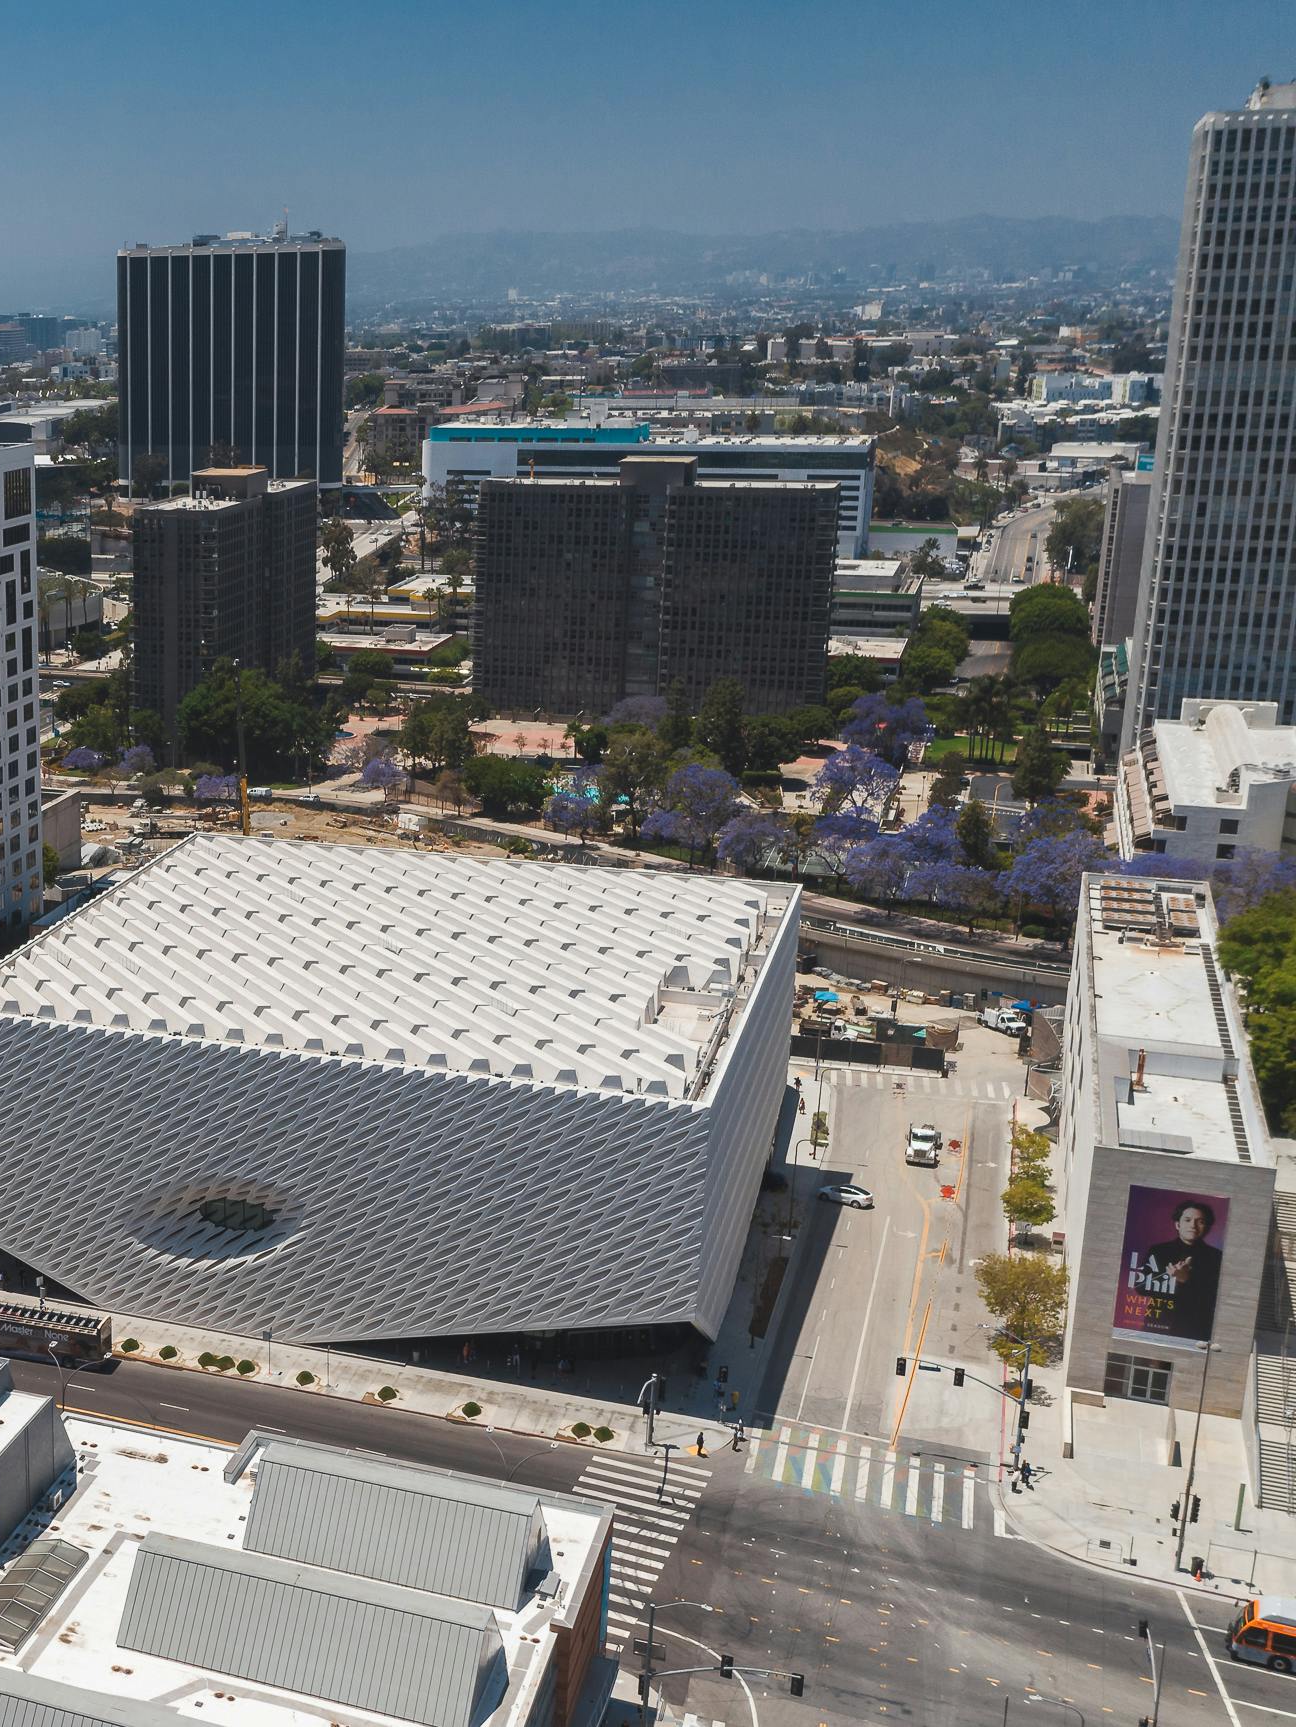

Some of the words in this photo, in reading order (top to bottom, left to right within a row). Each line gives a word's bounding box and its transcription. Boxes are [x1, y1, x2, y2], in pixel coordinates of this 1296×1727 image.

[1129, 1251, 1159, 1273] LA
[1127, 1270, 1177, 1294] Phil
[1126, 1294, 1174, 1310] WHAT'S
[1124, 1305, 1162, 1319] NEXT
[44, 1329, 69, 1342] None
